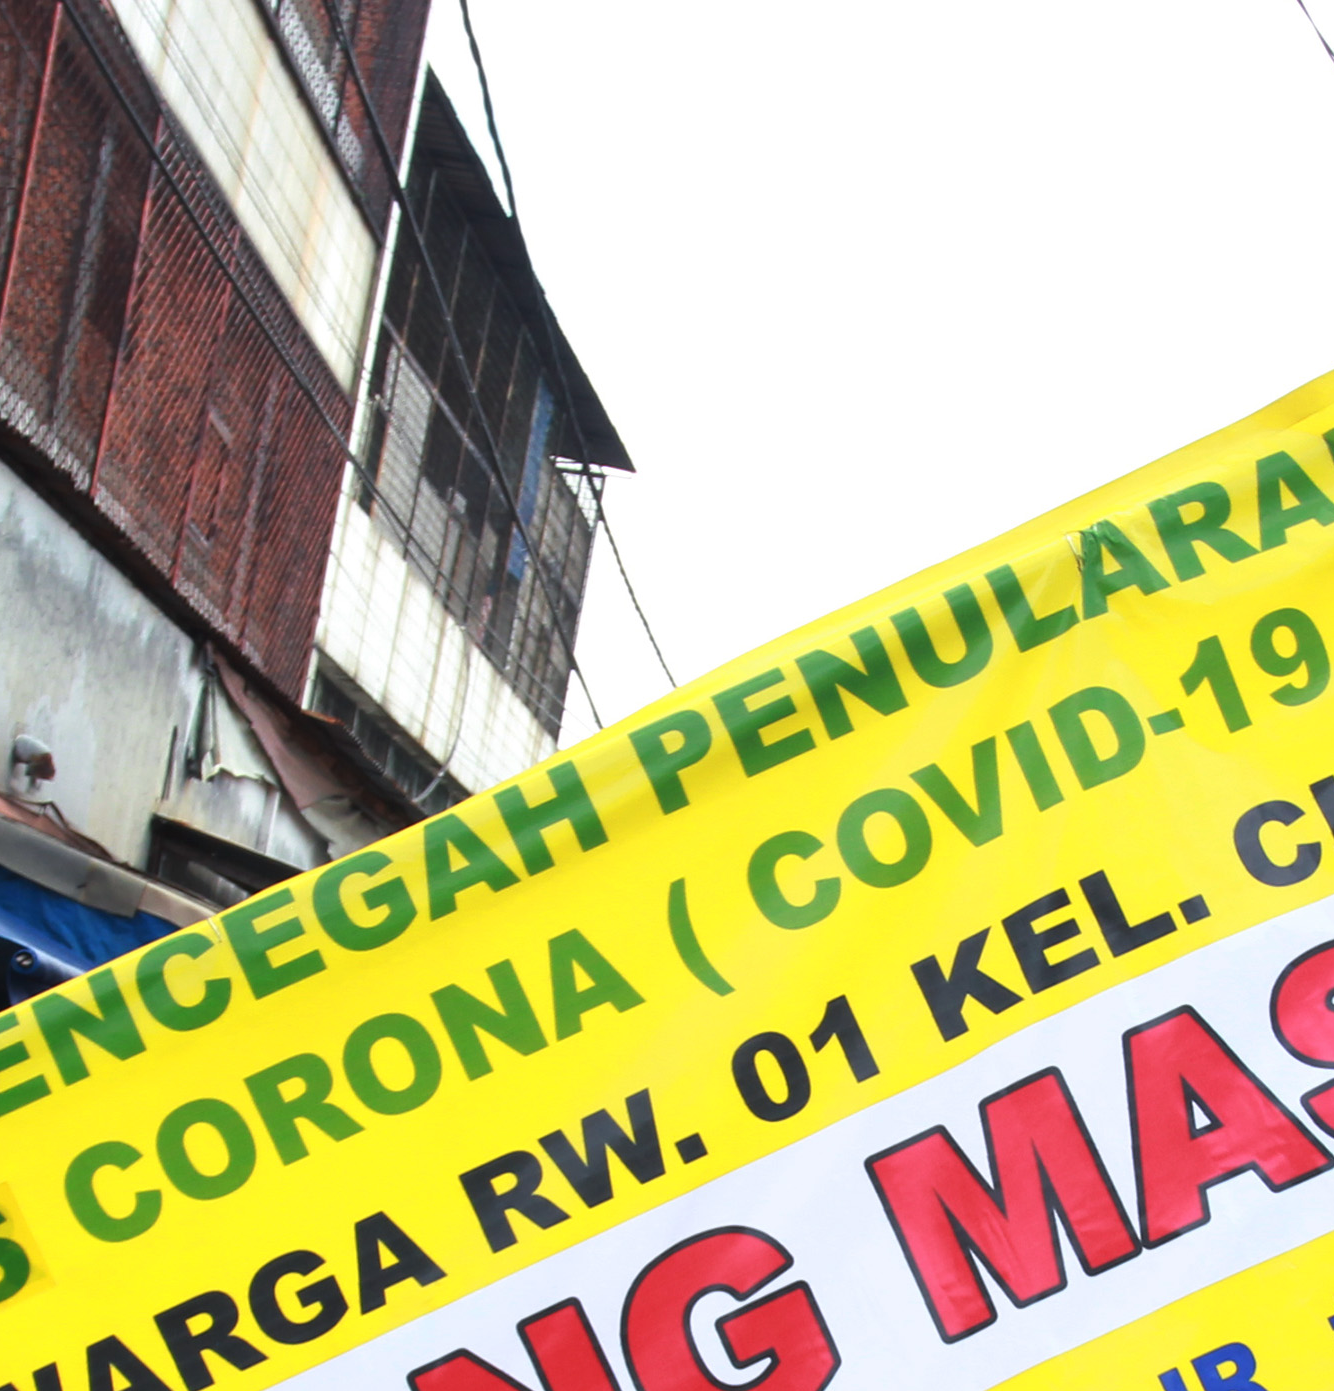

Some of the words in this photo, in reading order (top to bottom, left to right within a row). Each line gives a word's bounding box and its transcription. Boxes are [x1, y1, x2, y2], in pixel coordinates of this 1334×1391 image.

[63, 927, 646, 1243] CORONA
[667, 877, 736, 997] (
[746, 607, 1332, 930] COVID-19
[458, 1087, 708, 1253] RW.
[732, 994, 881, 1122] 01
[910, 869, 1212, 1043] KEL.
